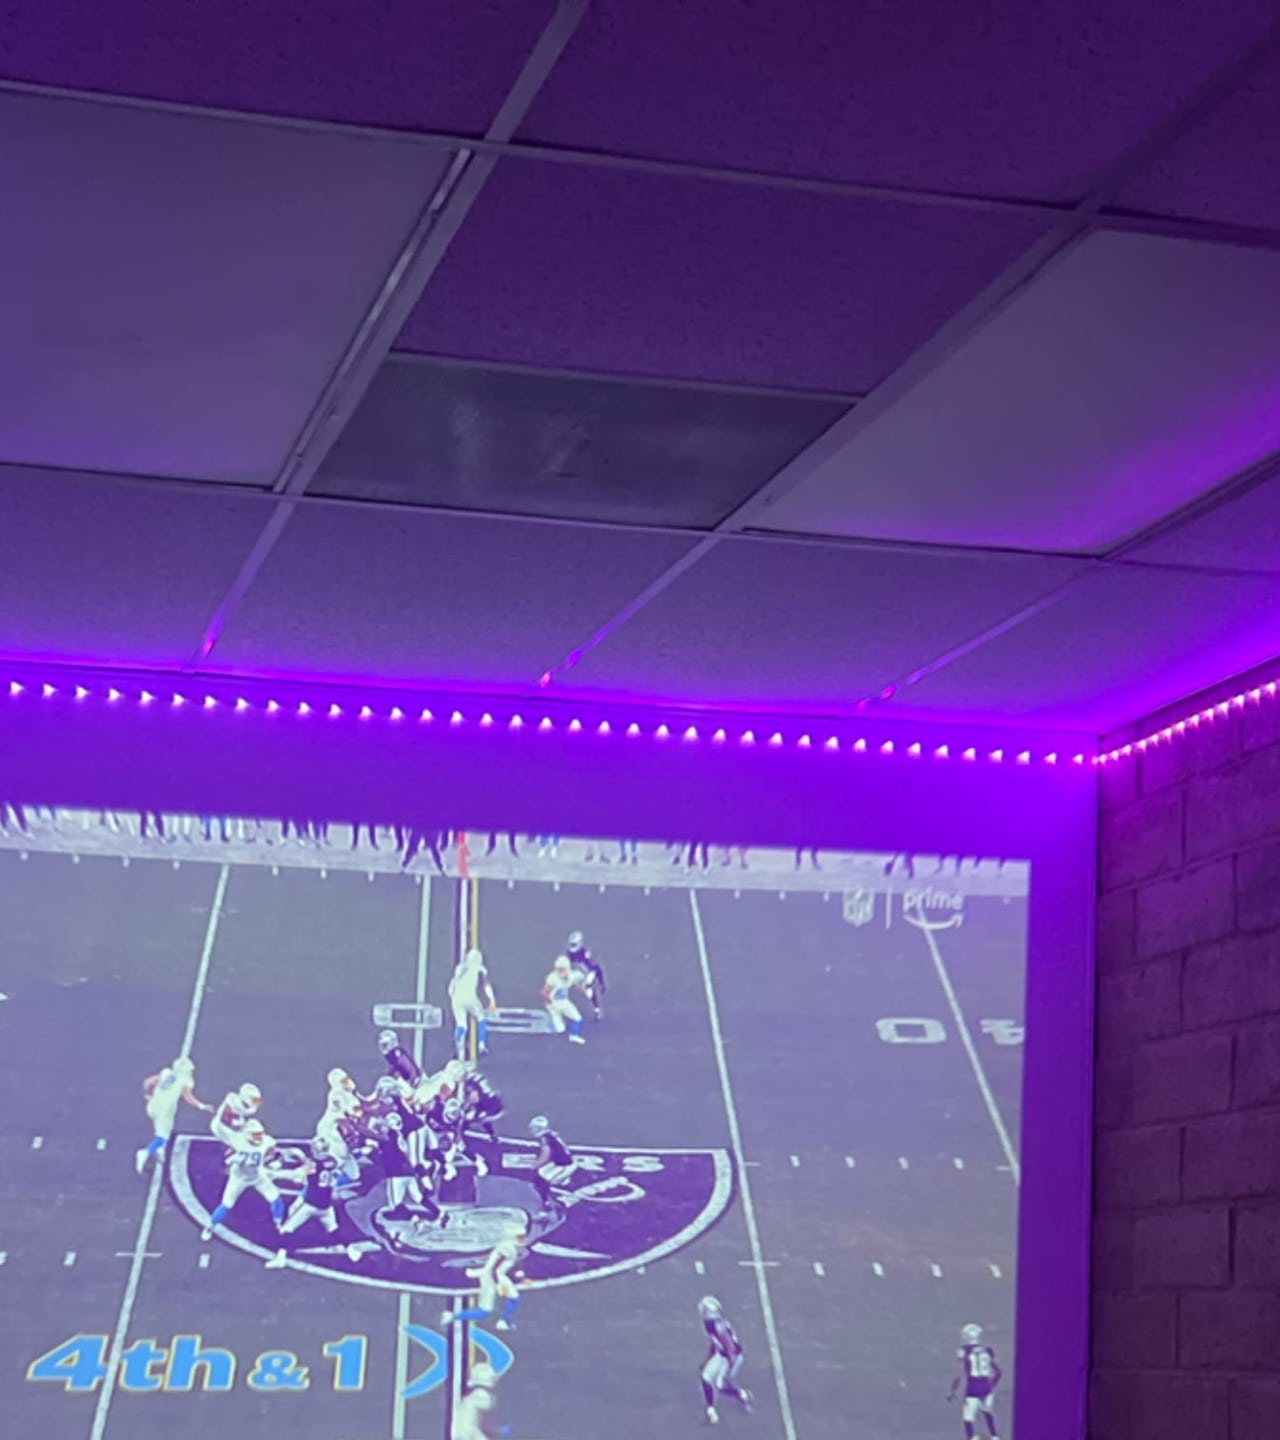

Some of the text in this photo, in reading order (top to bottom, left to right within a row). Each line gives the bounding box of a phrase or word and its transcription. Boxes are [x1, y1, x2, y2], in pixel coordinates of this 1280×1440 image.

[903, 886, 964, 913] prime
[26, 1334, 368, 1391] 4th & 1
